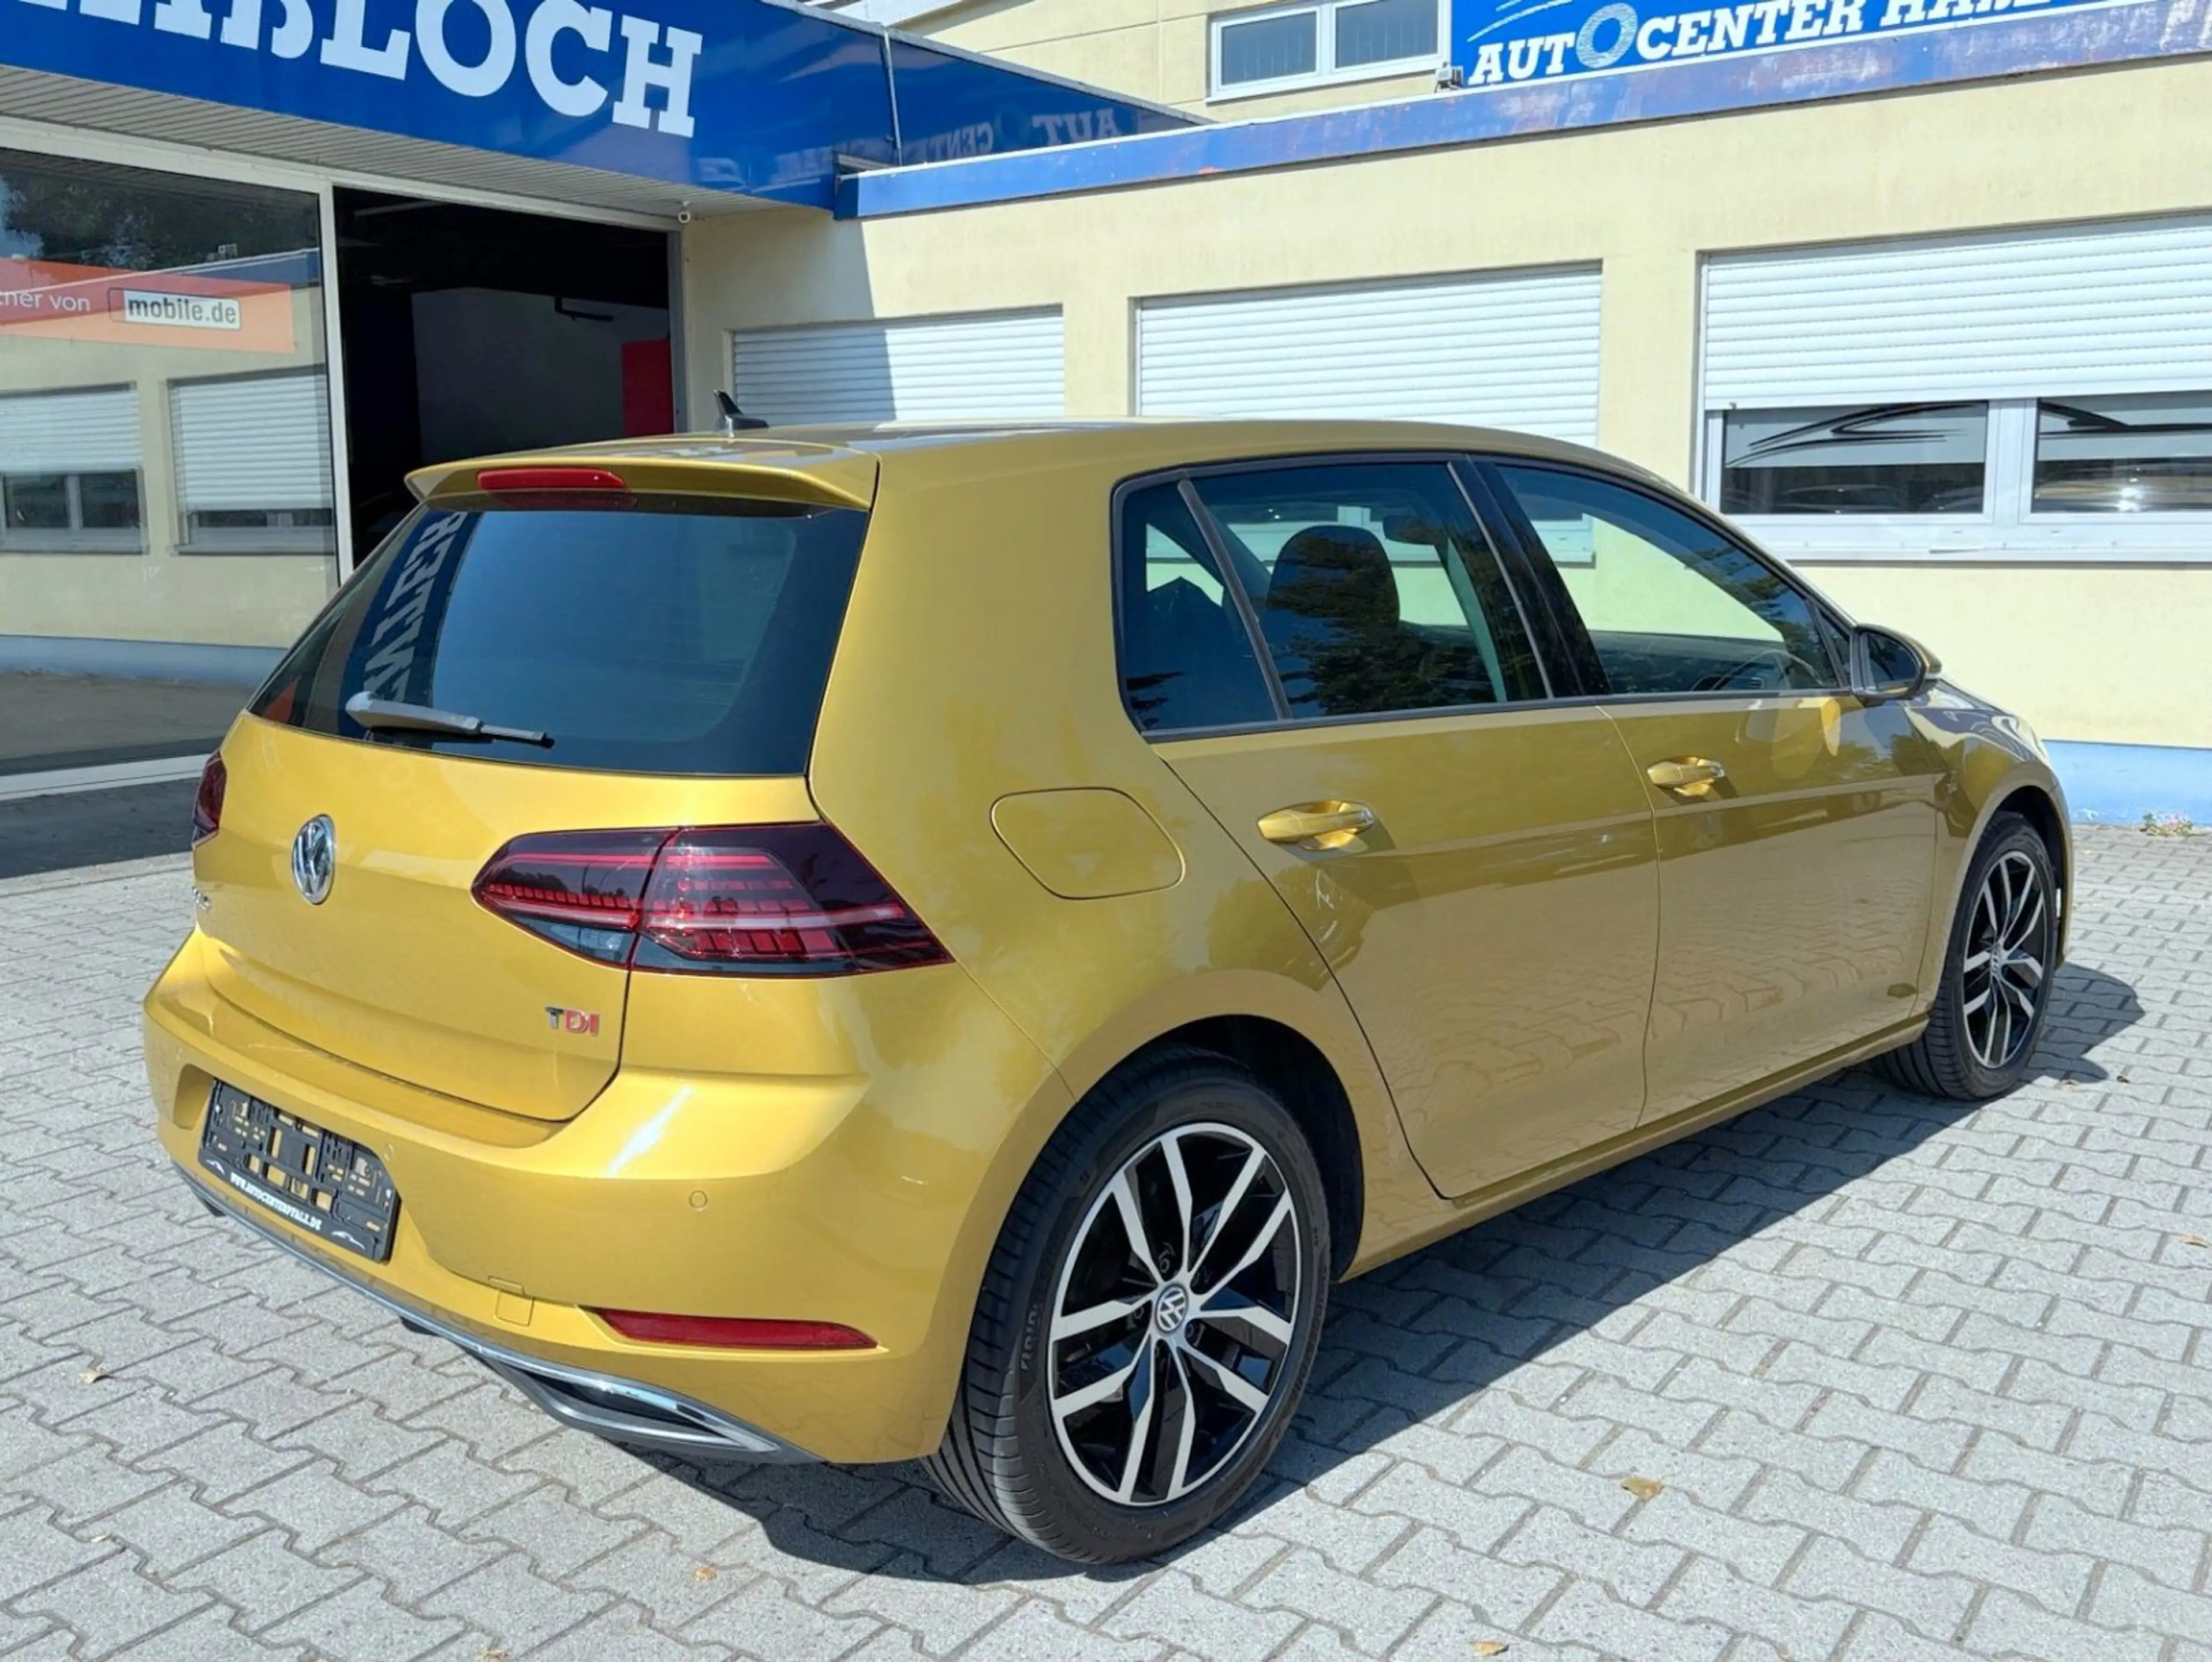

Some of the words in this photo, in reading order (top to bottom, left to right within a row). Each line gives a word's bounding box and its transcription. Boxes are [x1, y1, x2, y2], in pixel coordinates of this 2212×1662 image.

[1468, 0, 1866, 85] AUTOCENTER
[49, 295, 90, 312] von
[128, 298, 237, 324] mobile.de
[544, 1006, 600, 1037] TDI
